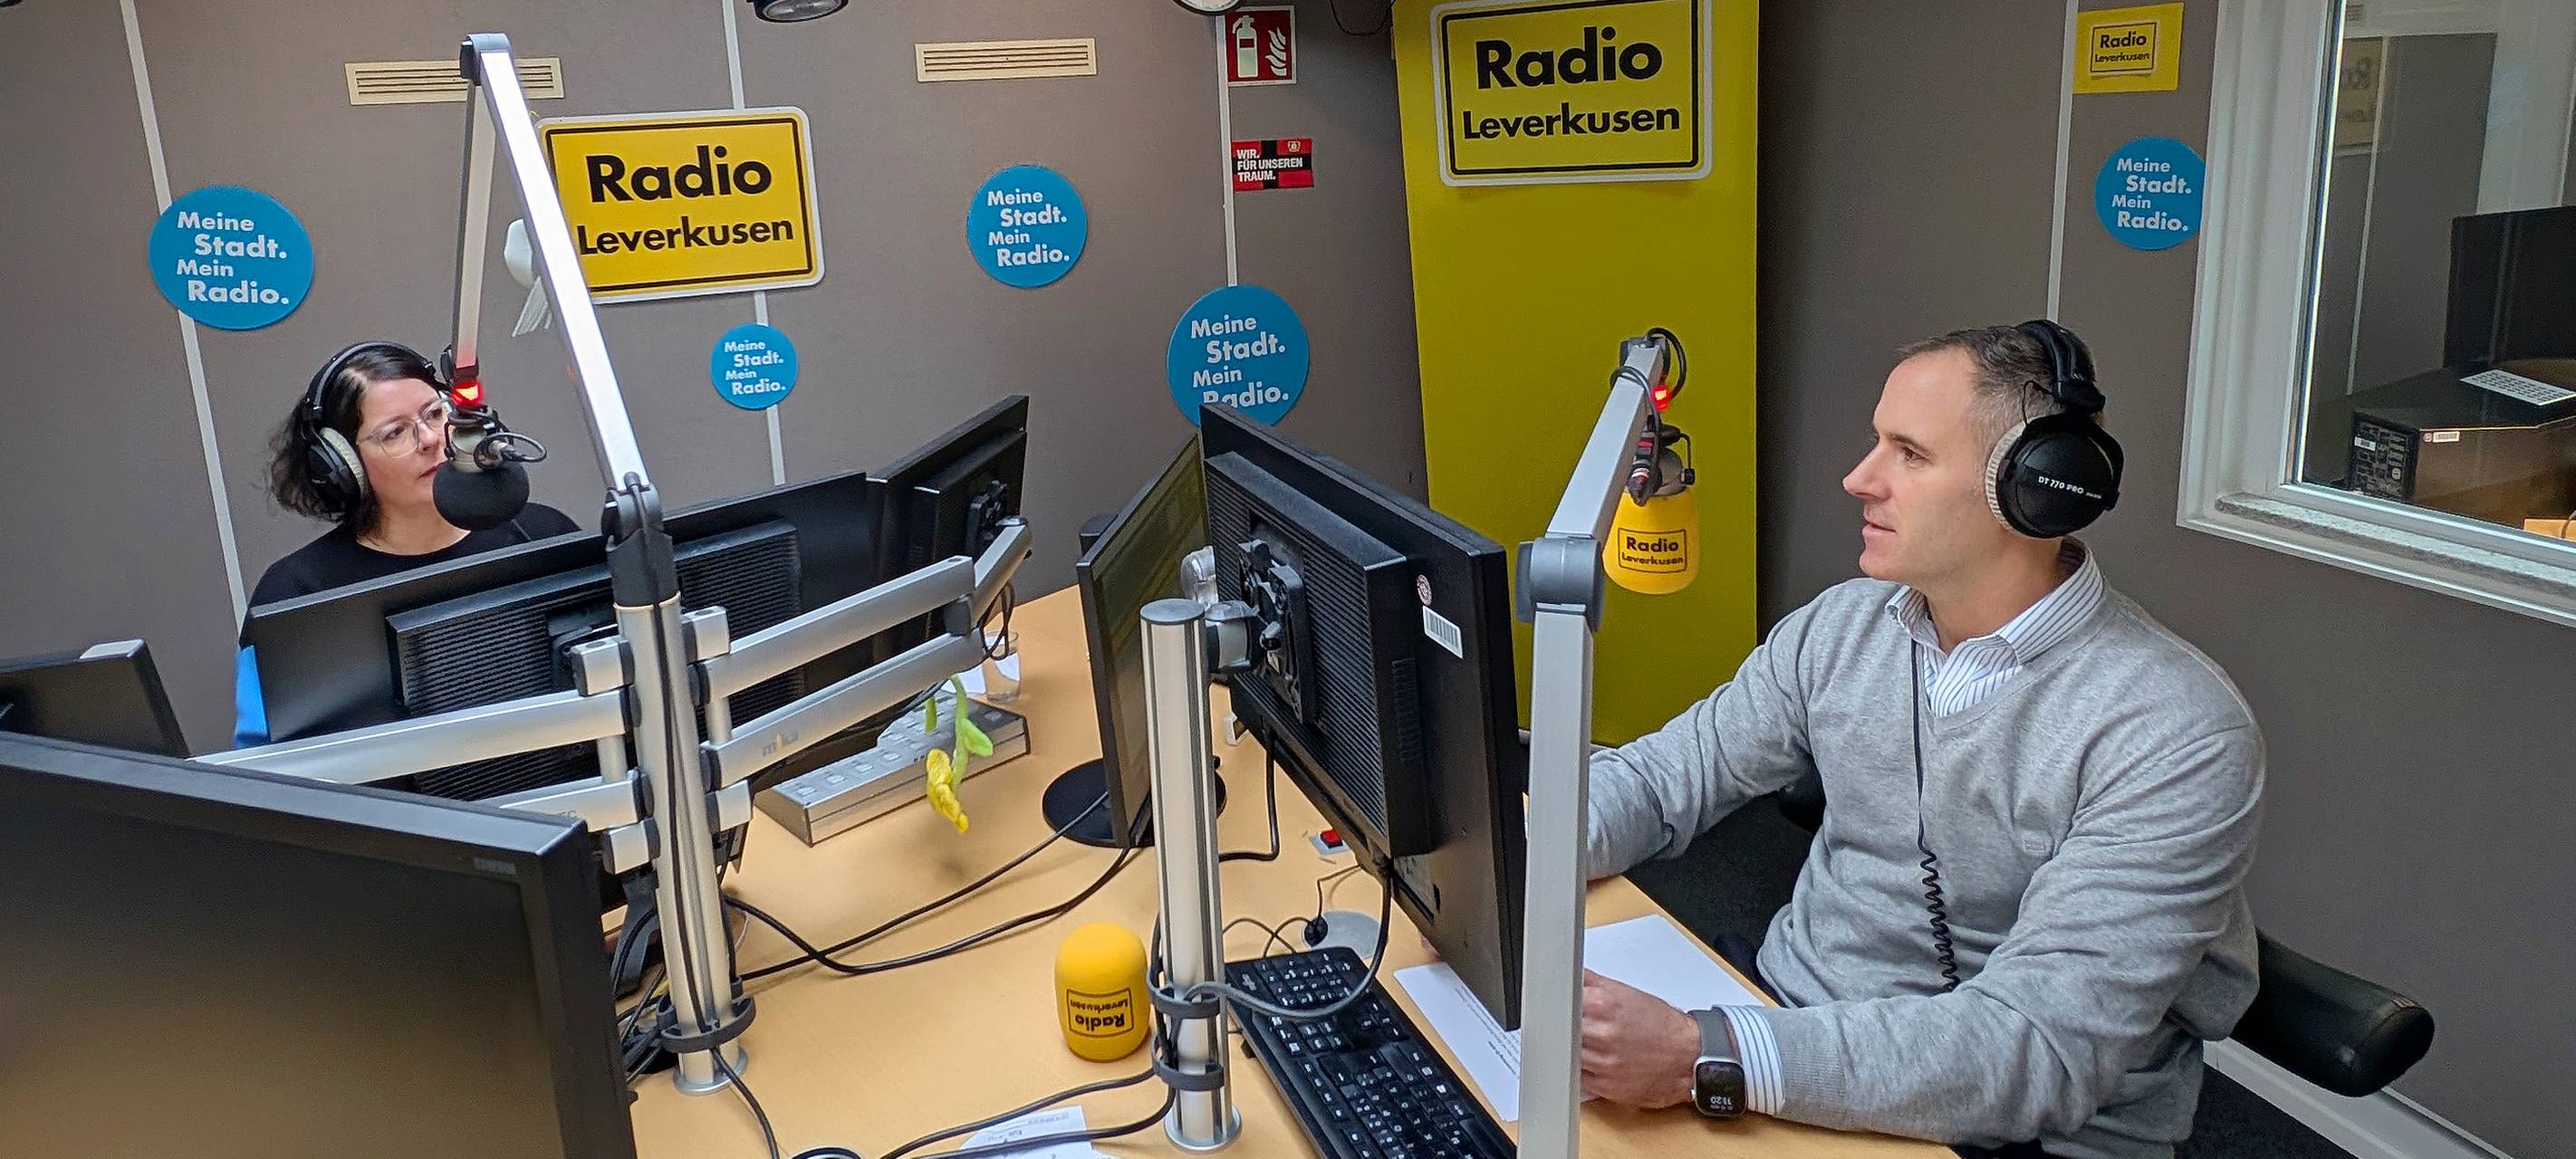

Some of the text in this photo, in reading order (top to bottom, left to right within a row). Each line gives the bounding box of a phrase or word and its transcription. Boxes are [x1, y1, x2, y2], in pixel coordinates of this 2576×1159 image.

[2100, 30, 2148, 49] Radio
[1475, 25, 1663, 90] Radio
[2094, 52, 2150, 62] Leverkusen
[1462, 101, 1680, 139] Leverkusen
[1236, 148, 1261, 159] WIR.
[1236, 157, 1303, 171] FÜR UNSEREN
[2116, 157, 2171, 173] Meine
[585, 145, 773, 203] Radio
[1237, 170, 1276, 183] TRAUM.
[2125, 174, 2192, 194] Stadt.
[986, 187, 1043, 206] Meine
[2111, 194, 2151, 209] Mein
[177, 210, 255, 232] Meine
[1000, 203, 1068, 228] Stadt.
[2117, 210, 2188, 232] Radio.
[576, 216, 794, 255] Leverkusen
[987, 228, 1031, 246] Mein
[194, 233, 288, 259] Stadt.
[996, 243, 1070, 267] Radio.
[176, 258, 235, 277] Mein
[187, 279, 290, 305] Radio.
[1190, 313, 1257, 340] Meine
[724, 339, 766, 353] Meine
[1206, 330, 1286, 364] Stadt.
[734, 350, 784, 368] Stadt.
[725, 368, 757, 380] Mein
[1192, 365, 1243, 388] Mein
[731, 378, 787, 396] Radio.
[2037, 475, 2084, 494] DT 770 PRO
[1626, 536, 1679, 553] Radio
[1621, 551, 1684, 566] Leverkusen
[1074, 1012, 1125, 1031] Radio
